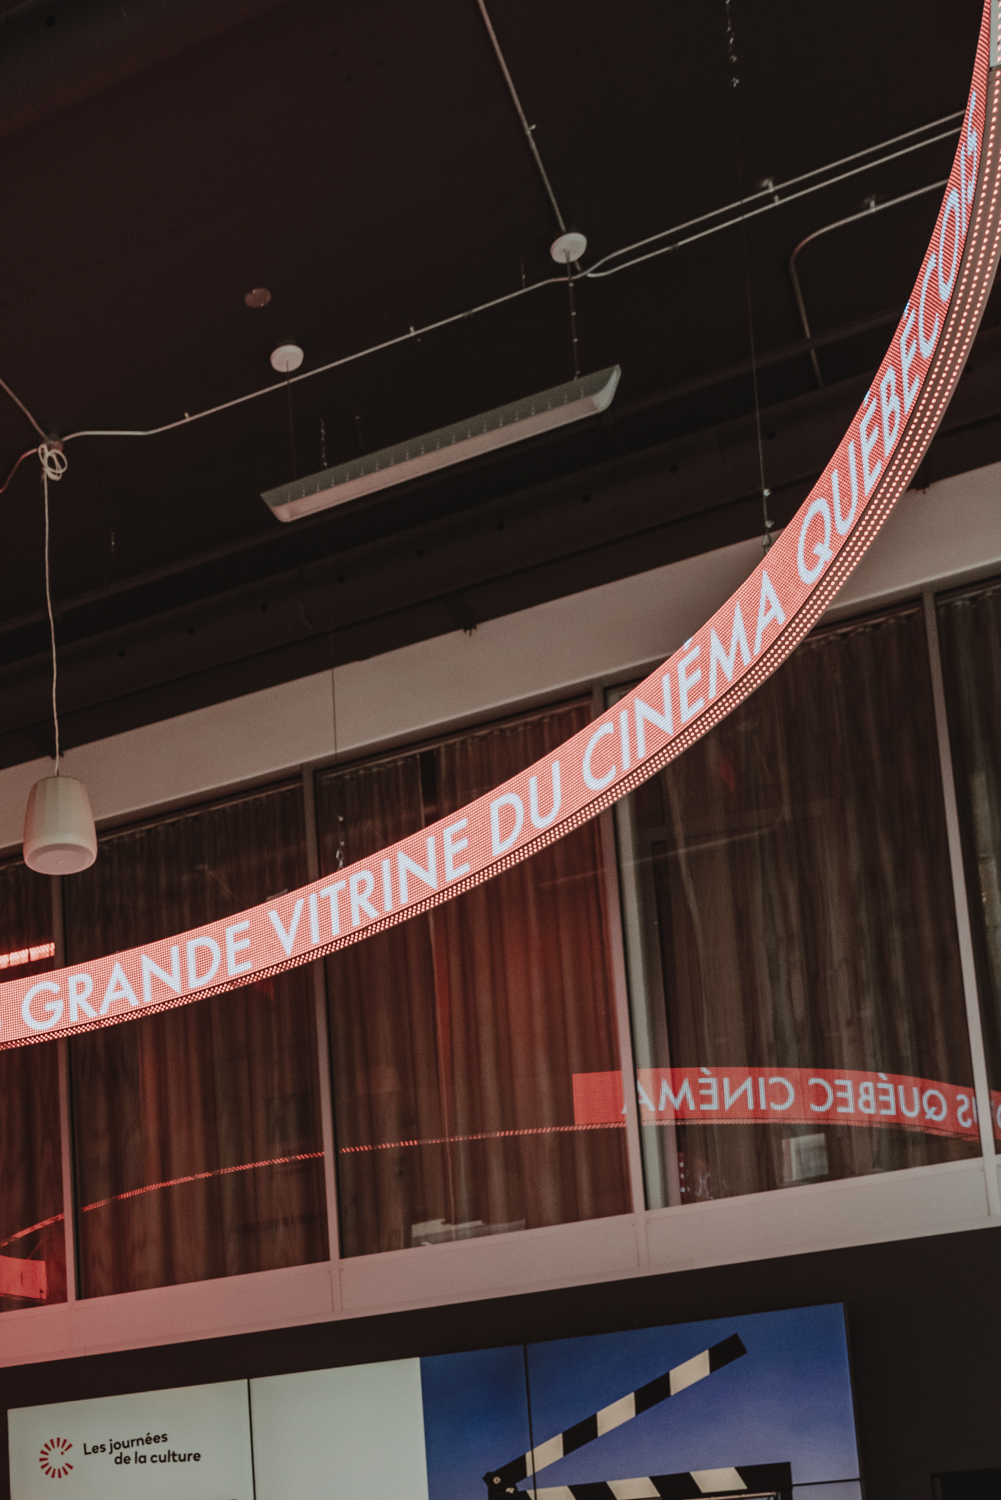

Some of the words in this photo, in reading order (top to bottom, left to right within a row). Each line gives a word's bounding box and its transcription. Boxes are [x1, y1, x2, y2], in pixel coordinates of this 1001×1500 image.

[21, 920, 253, 1031] GRANDE
[269, 817, 471, 958] VITRINE
[490, 761, 563, 857] DU
[83, 1443, 107, 1456] Les
[108, 1432, 168, 1455] journées
[114, 1451, 131, 1465] de
[134, 1451, 147, 1464] la
[150, 1449, 201, 1464] culture
